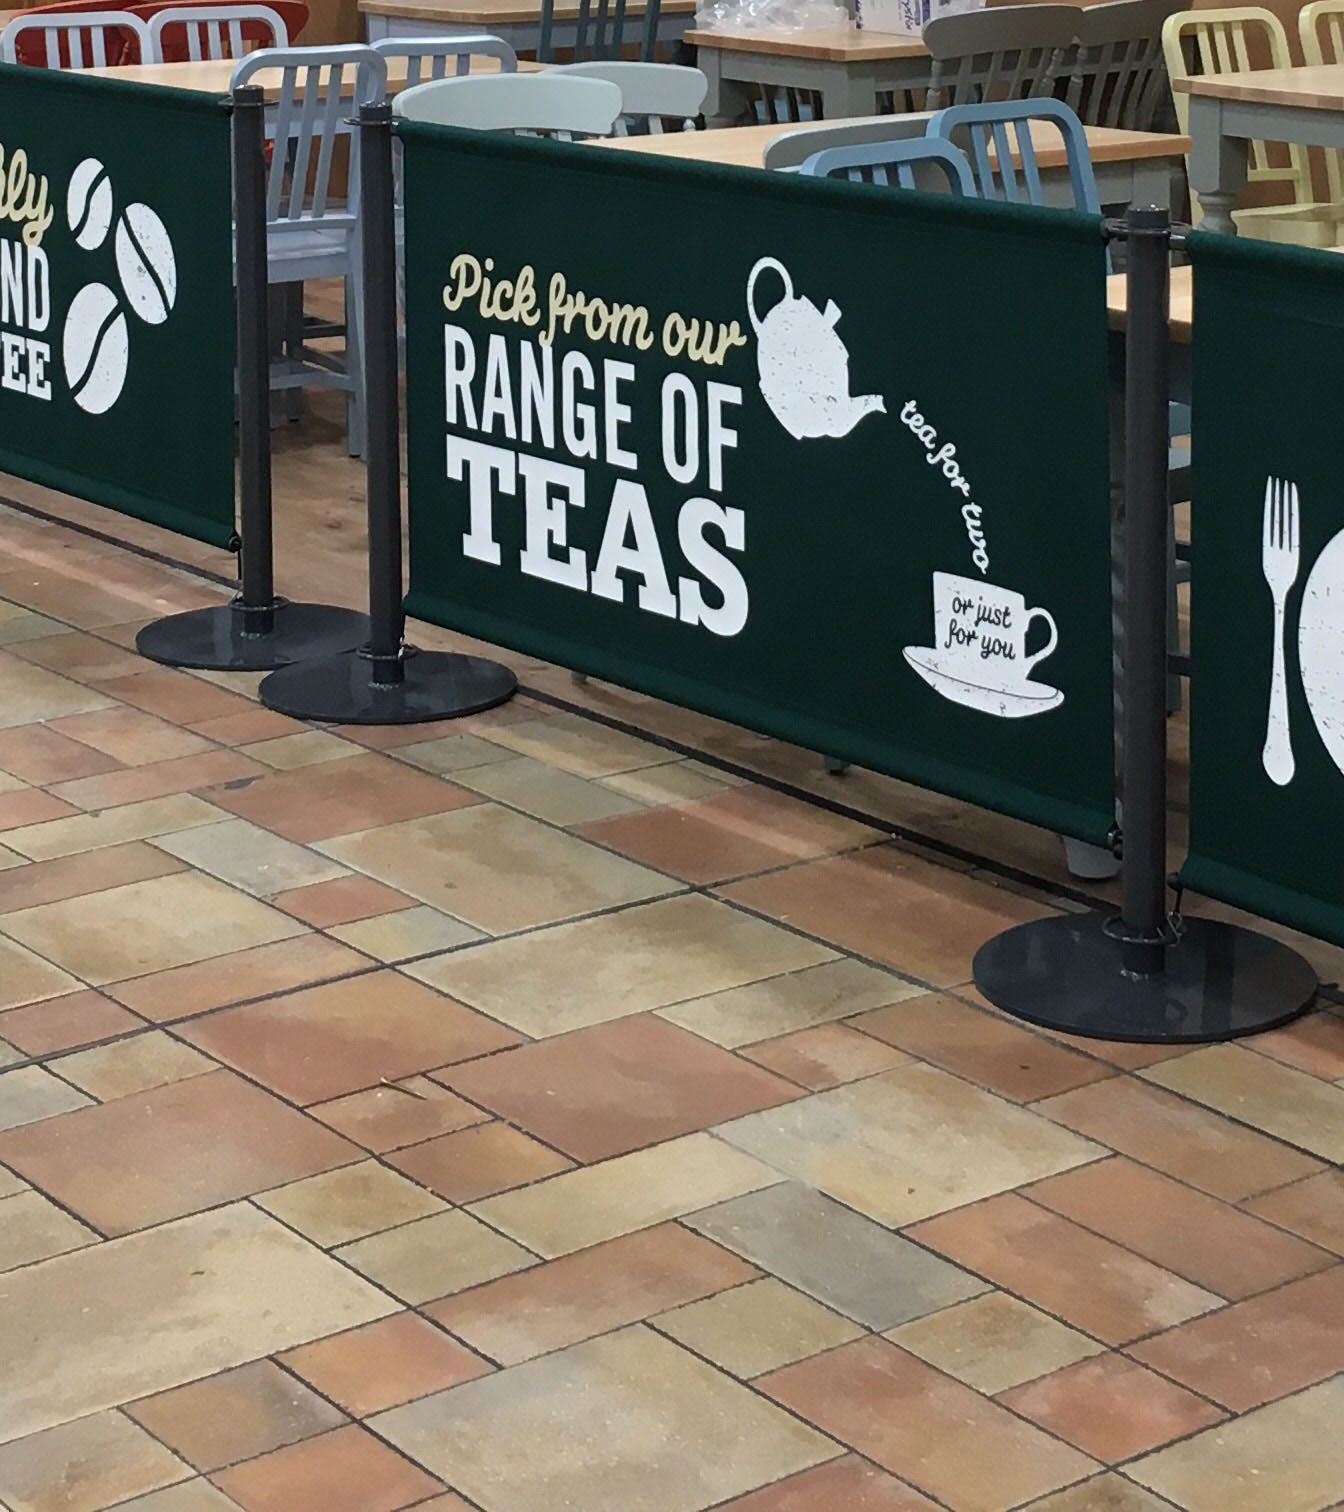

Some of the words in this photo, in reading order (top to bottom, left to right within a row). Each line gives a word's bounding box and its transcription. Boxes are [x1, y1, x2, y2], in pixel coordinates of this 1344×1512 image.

[443, 253, 541, 328] Pick
[537, 272, 654, 351] from
[662, 311, 747, 366] our
[444, 323, 638, 471] RANGE
[661, 371, 743, 492] OF
[446, 433, 749, 637] TEAS
[900, 400, 937, 449] tea
[926, 442, 970, 497] for
[961, 502, 990, 575] two
[944, 619, 978, 649] for
[981, 635, 1016, 660] you
[952, 596, 974, 615] or
[975, 596, 1012, 629] just
